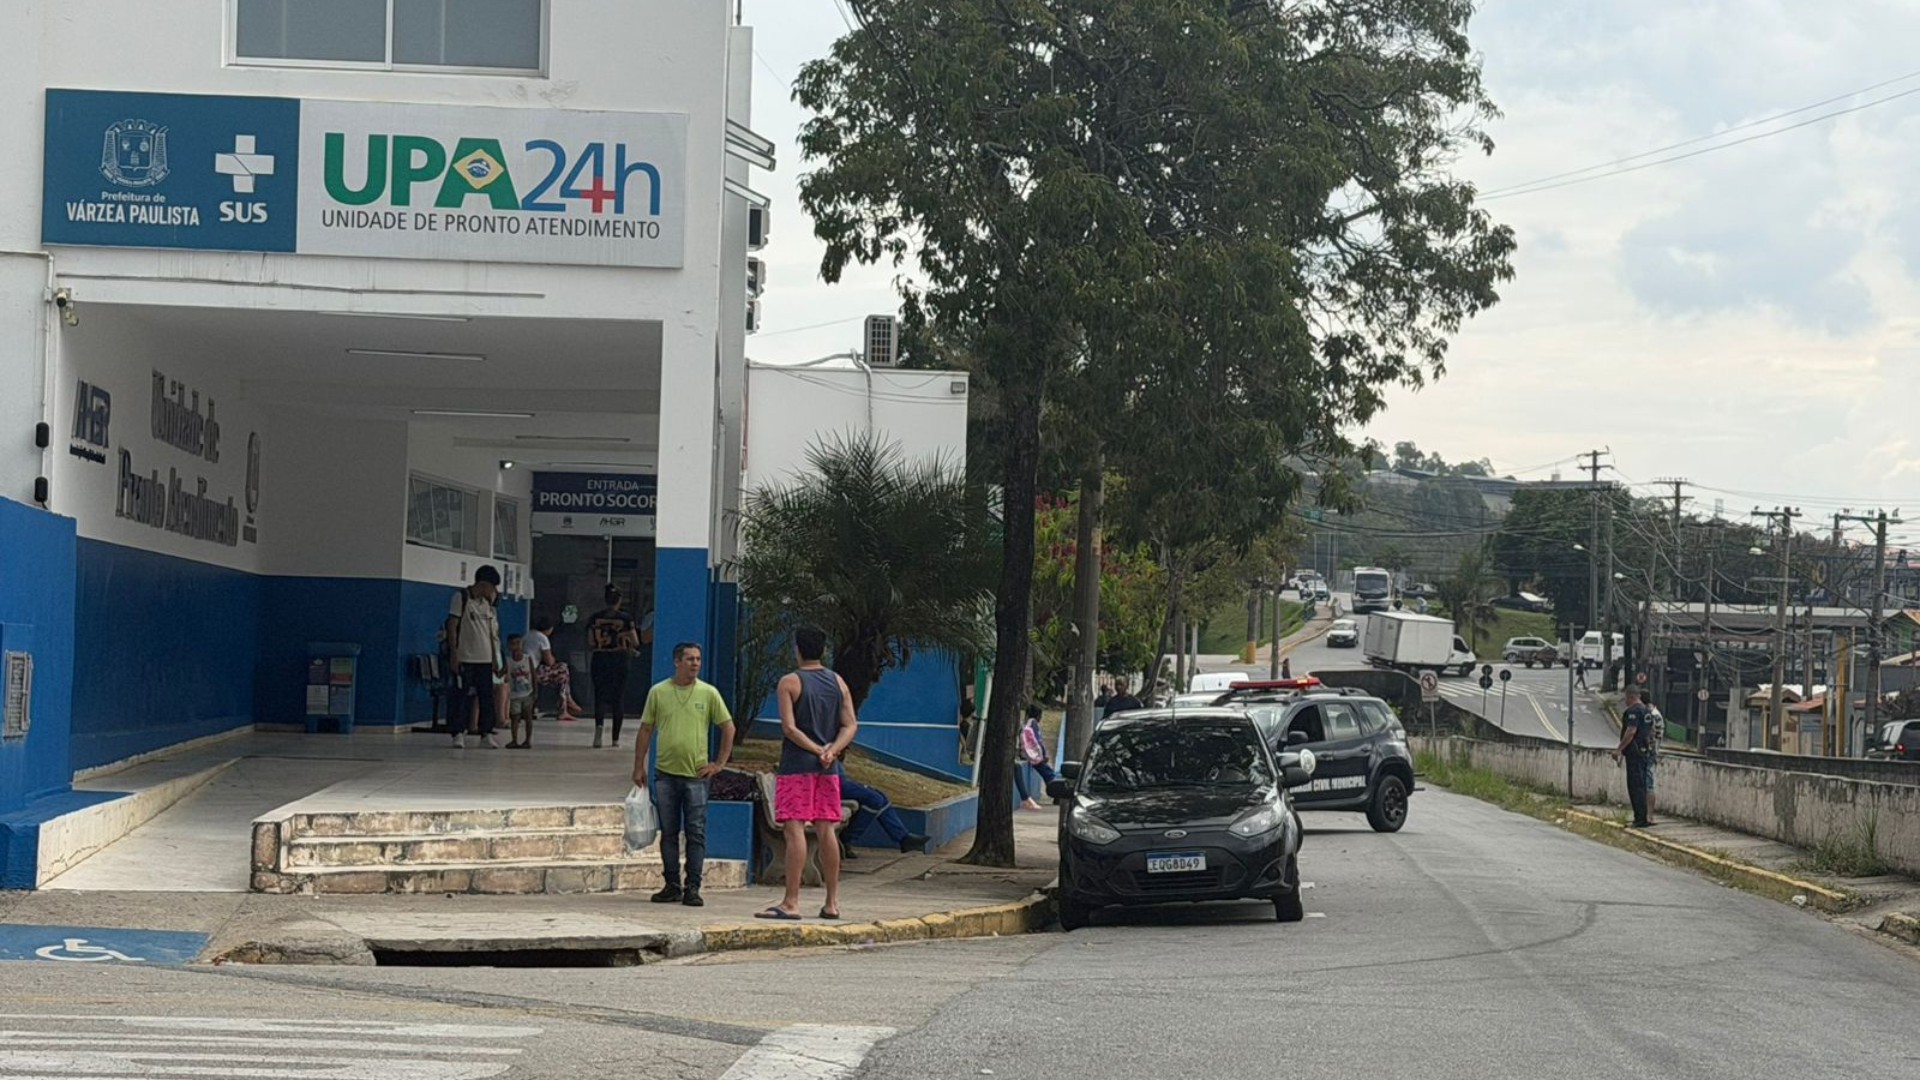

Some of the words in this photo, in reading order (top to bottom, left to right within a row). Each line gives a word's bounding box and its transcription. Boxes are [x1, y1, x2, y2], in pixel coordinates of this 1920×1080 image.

[324, 132, 520, 210] UPA
[521, 139, 661, 216] 24h
[101, 191, 151, 202] Prefeitura
[152, 192, 166, 202] de
[66, 199, 125, 223] VÁRZEA
[130, 204, 200, 226] PAULISTA
[219, 201, 268, 223] SUS
[321, 209, 407, 231] UNIDADE
[414, 213, 438, 231] DE
[445, 214, 520, 235] PRONTO
[525, 216, 661, 240] ATENDIMENTO
[587, 480, 639, 491] ENTRADA
[540, 492, 604, 507] PRONTO
[1313, 778, 1330, 792] CIVIL
[1331, 775, 1367, 790] MUNICIPAL
